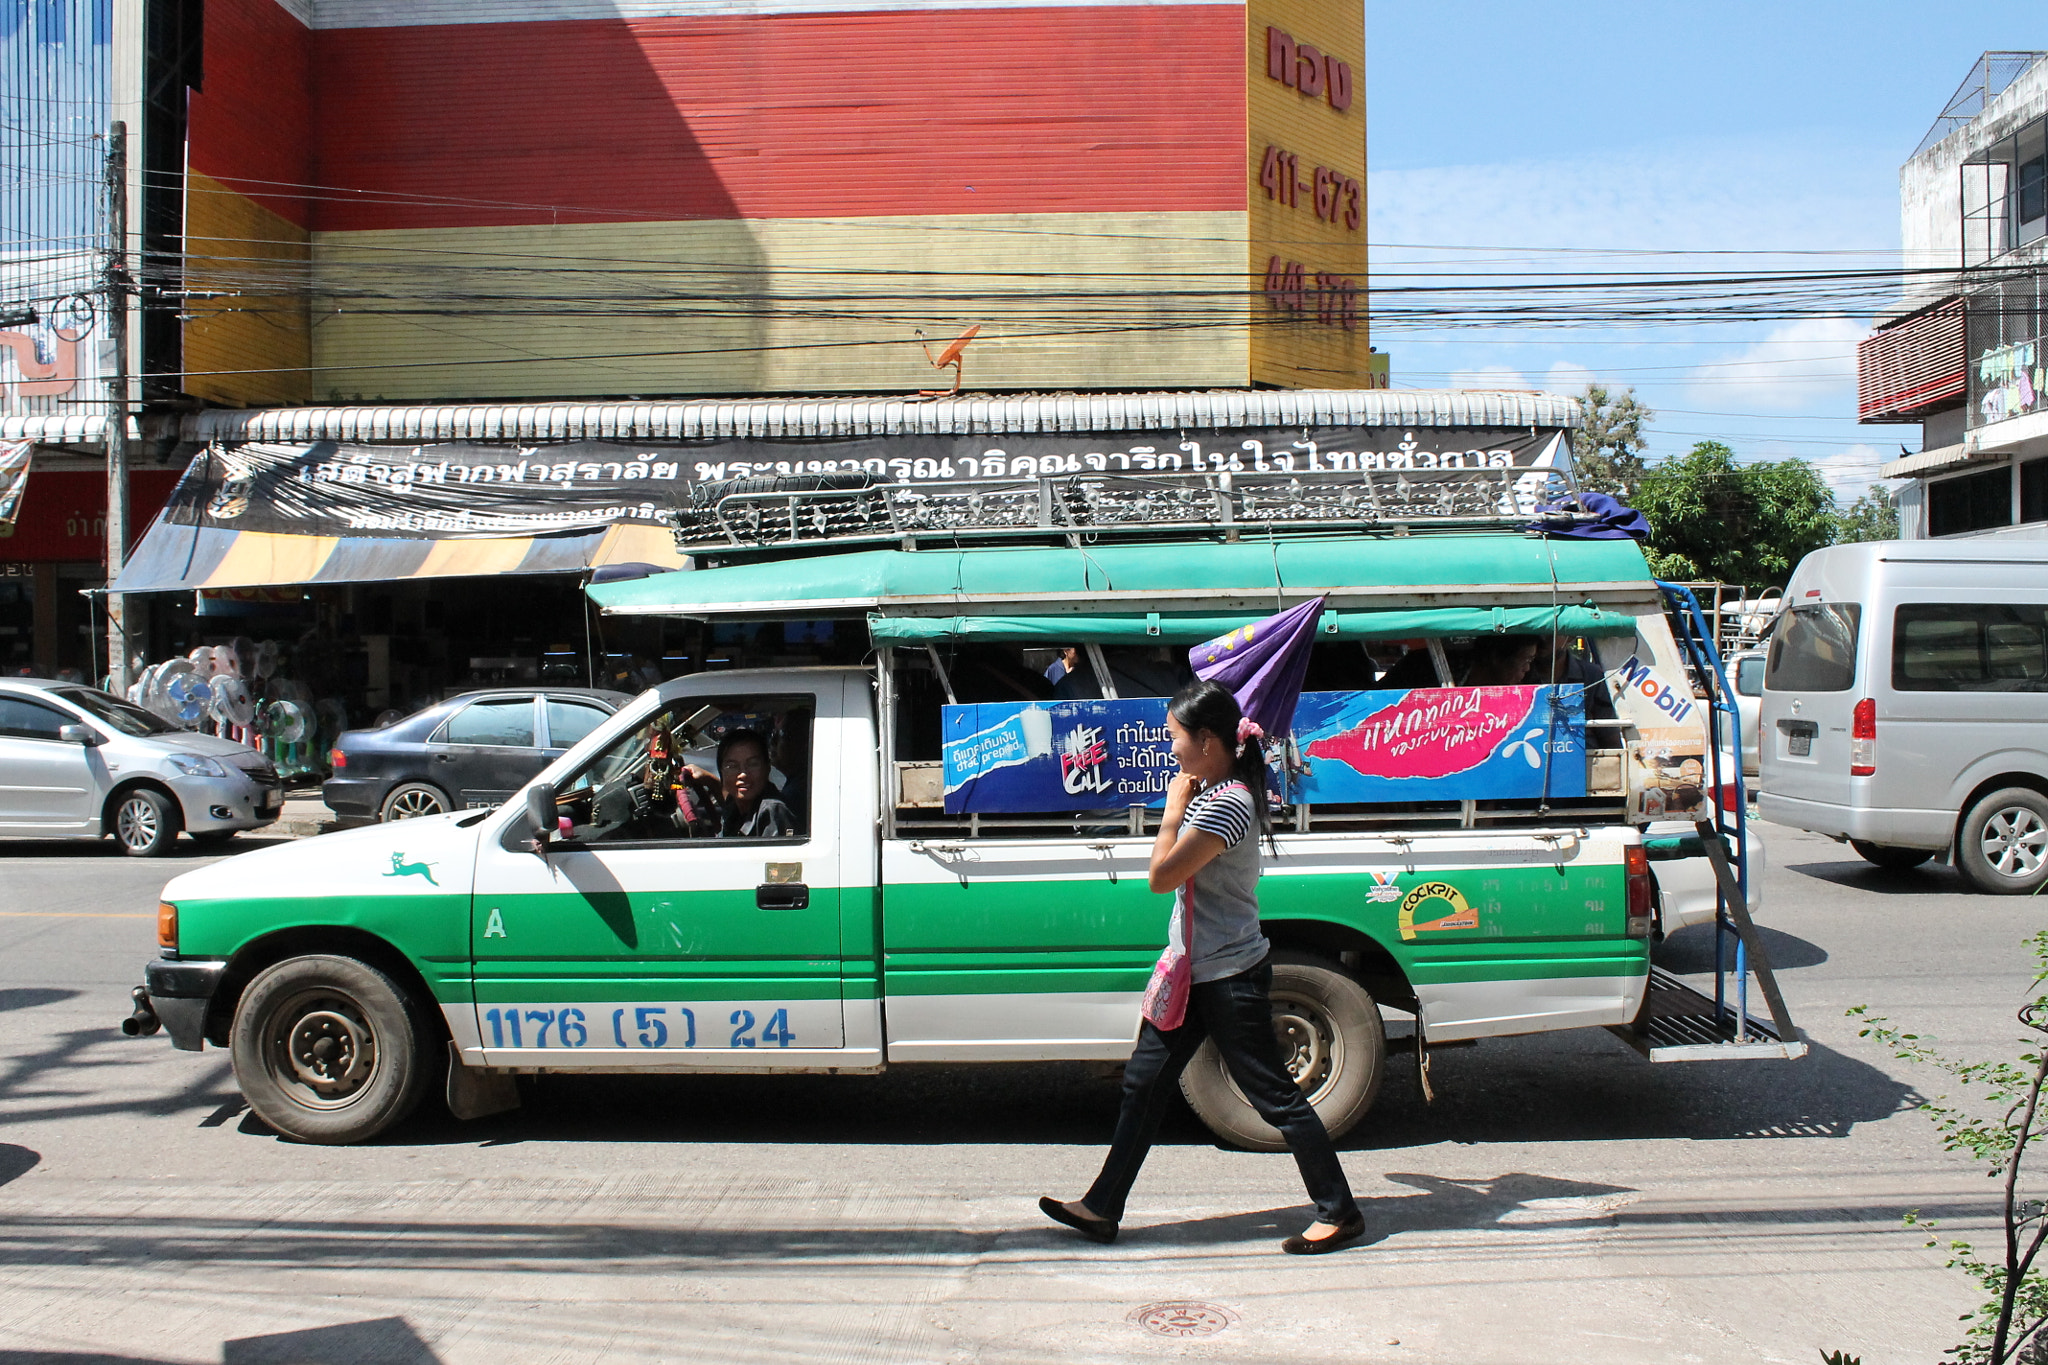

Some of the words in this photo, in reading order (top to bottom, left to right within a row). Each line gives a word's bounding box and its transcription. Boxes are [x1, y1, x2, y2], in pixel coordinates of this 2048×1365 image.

[1267, 26, 1352, 111] ทอง
[1260, 145, 1361, 230] 411-673
[1619, 657, 1693, 723] Mobil
[953, 730, 1017, 762] ดีแทคเติมเงิน
[956, 757, 979, 772] dtac
[981, 739, 1019, 765] prepaid
[1070, 723, 1103, 756] NET
[1060, 739, 1107, 785] FREE
[1064, 764, 1113, 794] CALL
[1402, 883, 1458, 912] COCKPIT
[483, 908, 508, 938] A
[486, 1008, 588, 1048] 1176
[730, 1008, 796, 1047] 24
